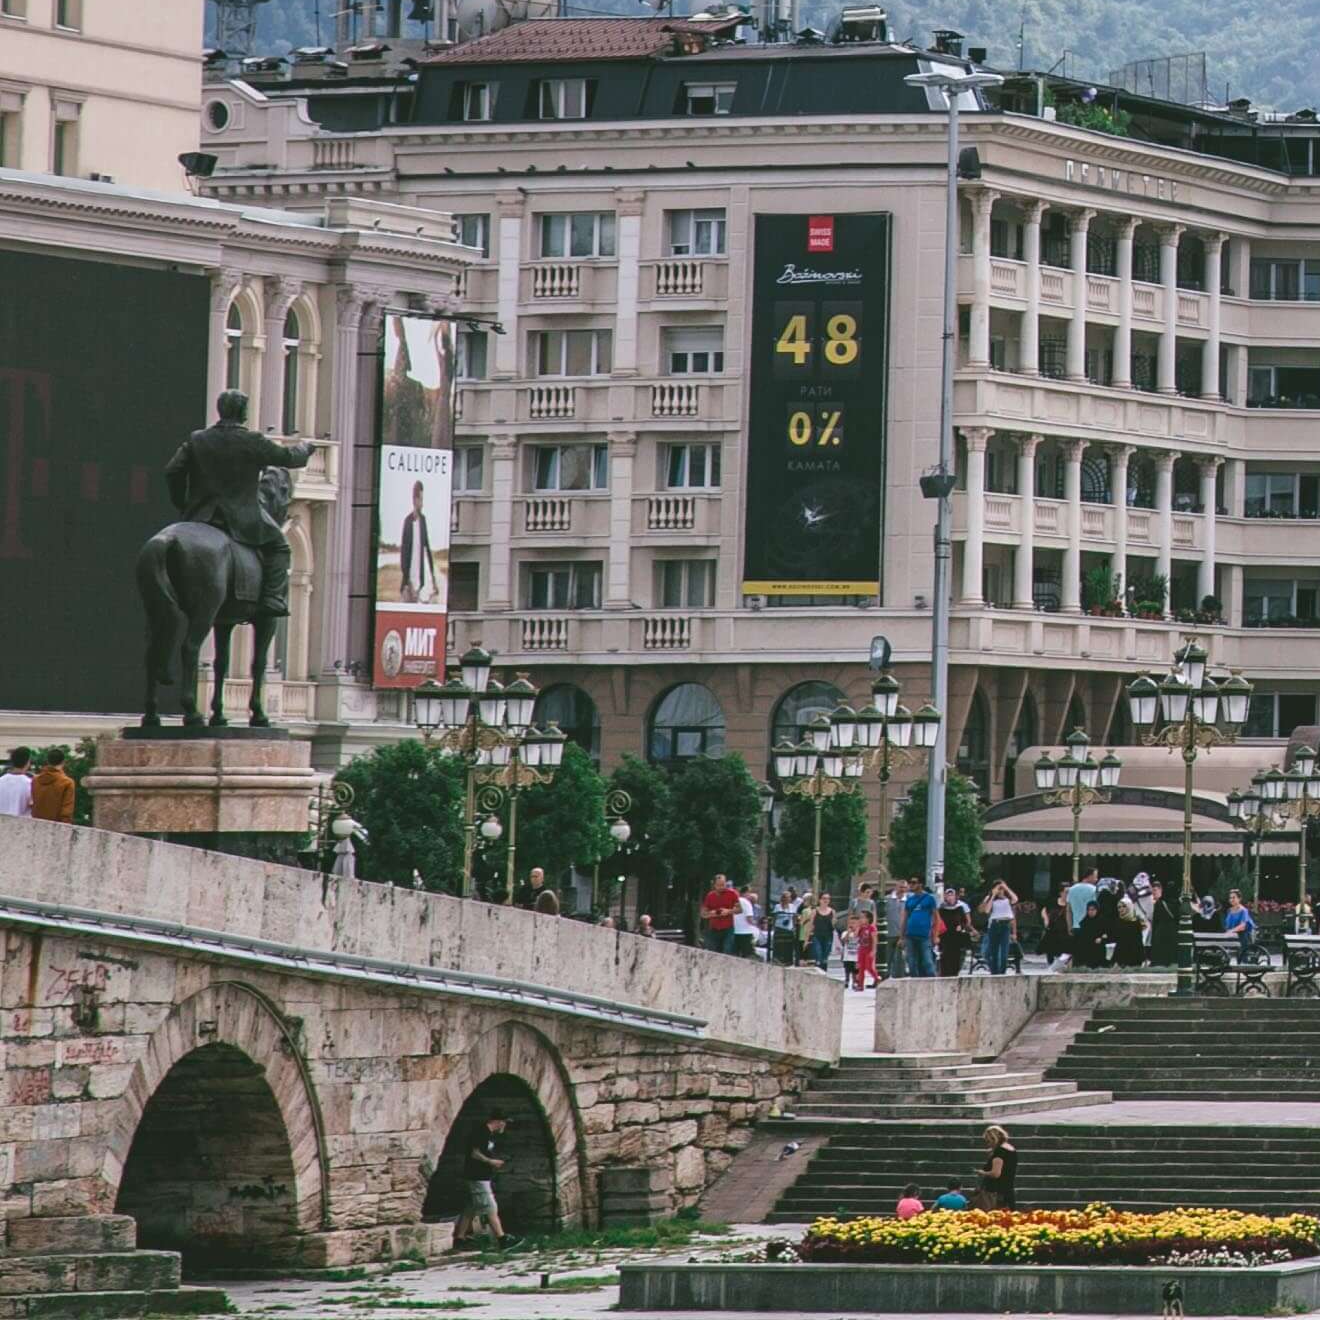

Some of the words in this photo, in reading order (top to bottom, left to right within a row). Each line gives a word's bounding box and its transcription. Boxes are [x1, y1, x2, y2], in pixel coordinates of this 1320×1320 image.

[809, 227, 832, 236] SWISS
[809, 238, 830, 247] MADE
[776, 314, 858, 365] 48
[800, 386, 832, 398] РАТИ
[788, 410, 841, 446] 0%
[388, 452, 447, 475] CALLIOPE
[787, 459, 841, 472] КАМАТА
[405, 627, 437, 657] МИТ
